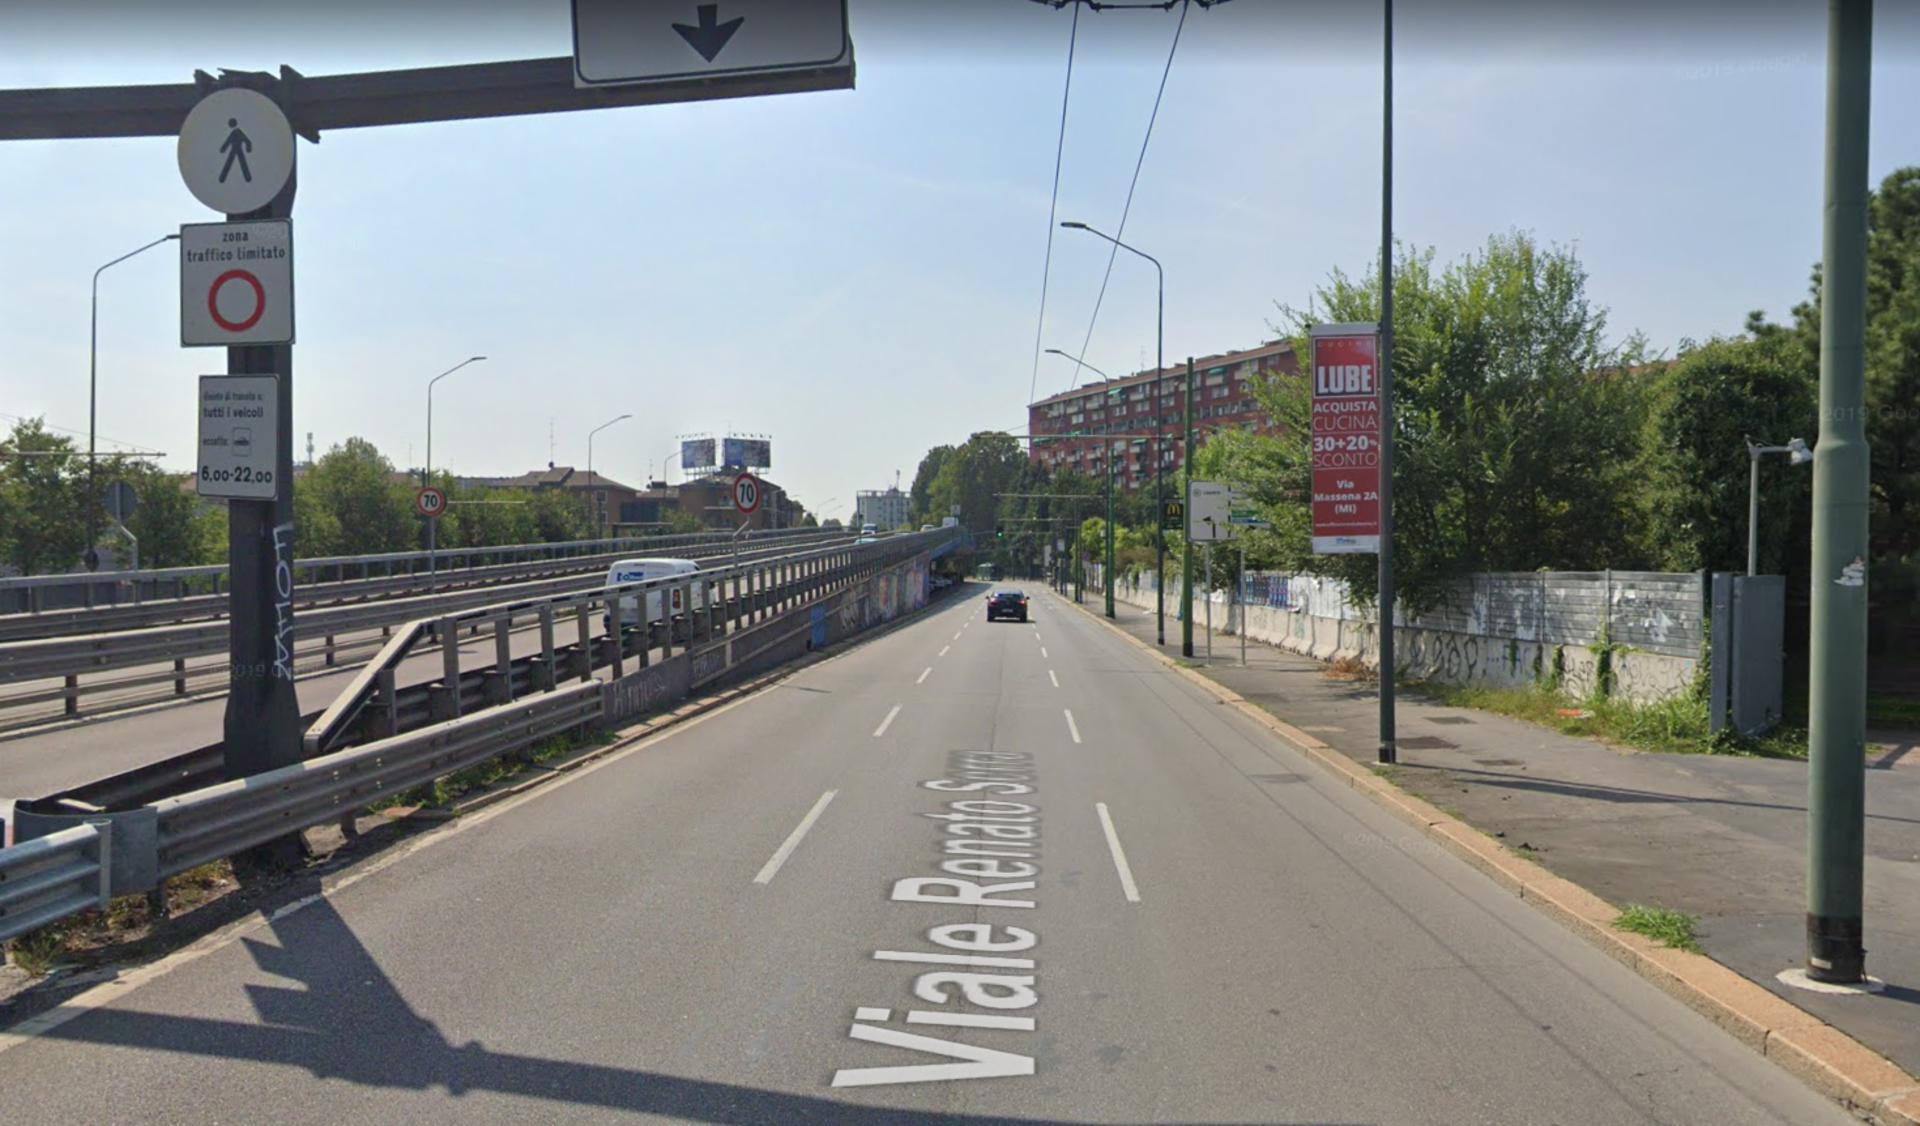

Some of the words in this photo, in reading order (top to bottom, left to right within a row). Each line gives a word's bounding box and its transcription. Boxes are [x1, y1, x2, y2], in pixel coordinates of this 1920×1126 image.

[222, 231, 249, 242] zona
[187, 248, 233, 262] traffico
[237, 245, 286, 260] limitato
[1317, 364, 1372, 394] LUBE
[203, 406, 225, 418] tutti
[233, 406, 264, 418] veicoli
[1313, 401, 1377, 414] ACQUISTA
[1313, 415, 1377, 431] CUCINA
[1313, 452, 1378, 467] SCONTO
[1336, 479, 1355, 489] Via
[741, 483, 755, 503] 70
[423, 494, 438, 508] 70
